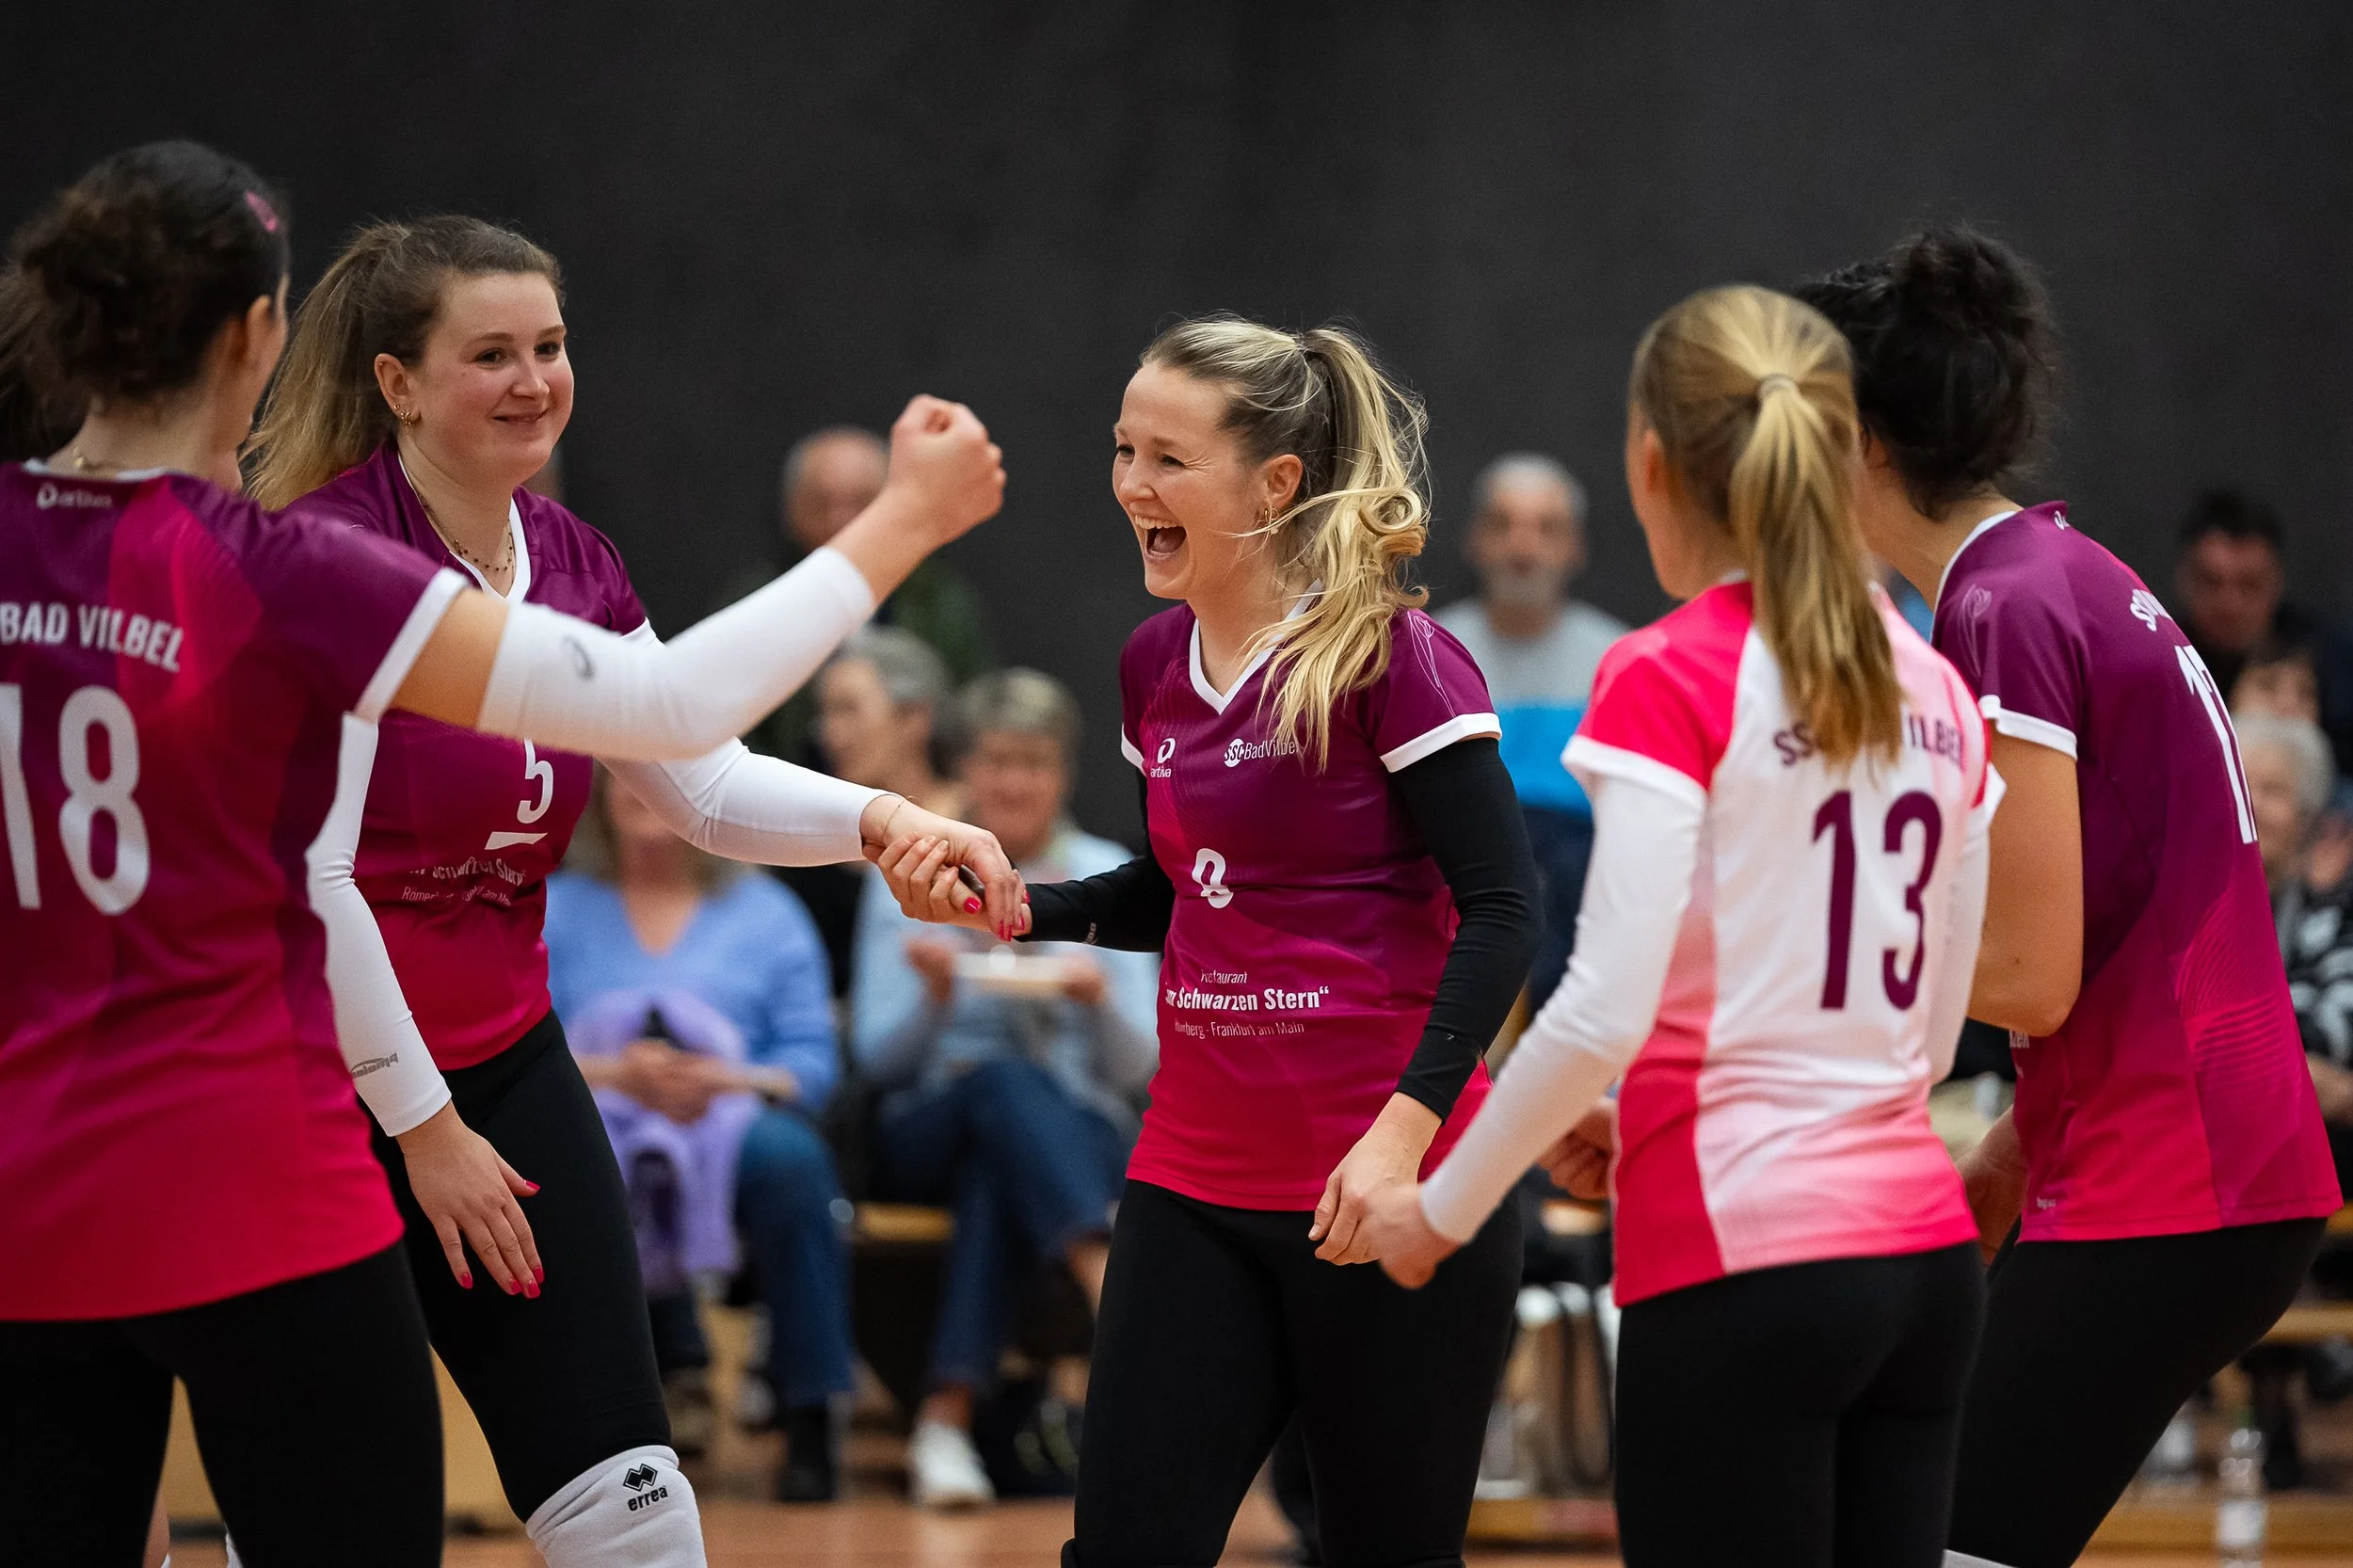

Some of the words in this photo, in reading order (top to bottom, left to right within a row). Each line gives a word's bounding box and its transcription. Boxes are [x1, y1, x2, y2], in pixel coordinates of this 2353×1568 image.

[0, 600, 70, 645] BAD
[77, 602, 185, 674] VILBEL
[1149, 766, 1172, 778] artiva
[1772, 721, 1814, 769] SS
[0, 682, 151, 916] 18
[516, 737, 554, 824] 5
[1812, 791, 1943, 1012] 13
[1176, 986, 1258, 1012] Schwarzen
[1210, 1021, 1257, 1037] Frankfurt
[1257, 1024, 1275, 1035] am
[1275, 1021, 1305, 1035] Main
